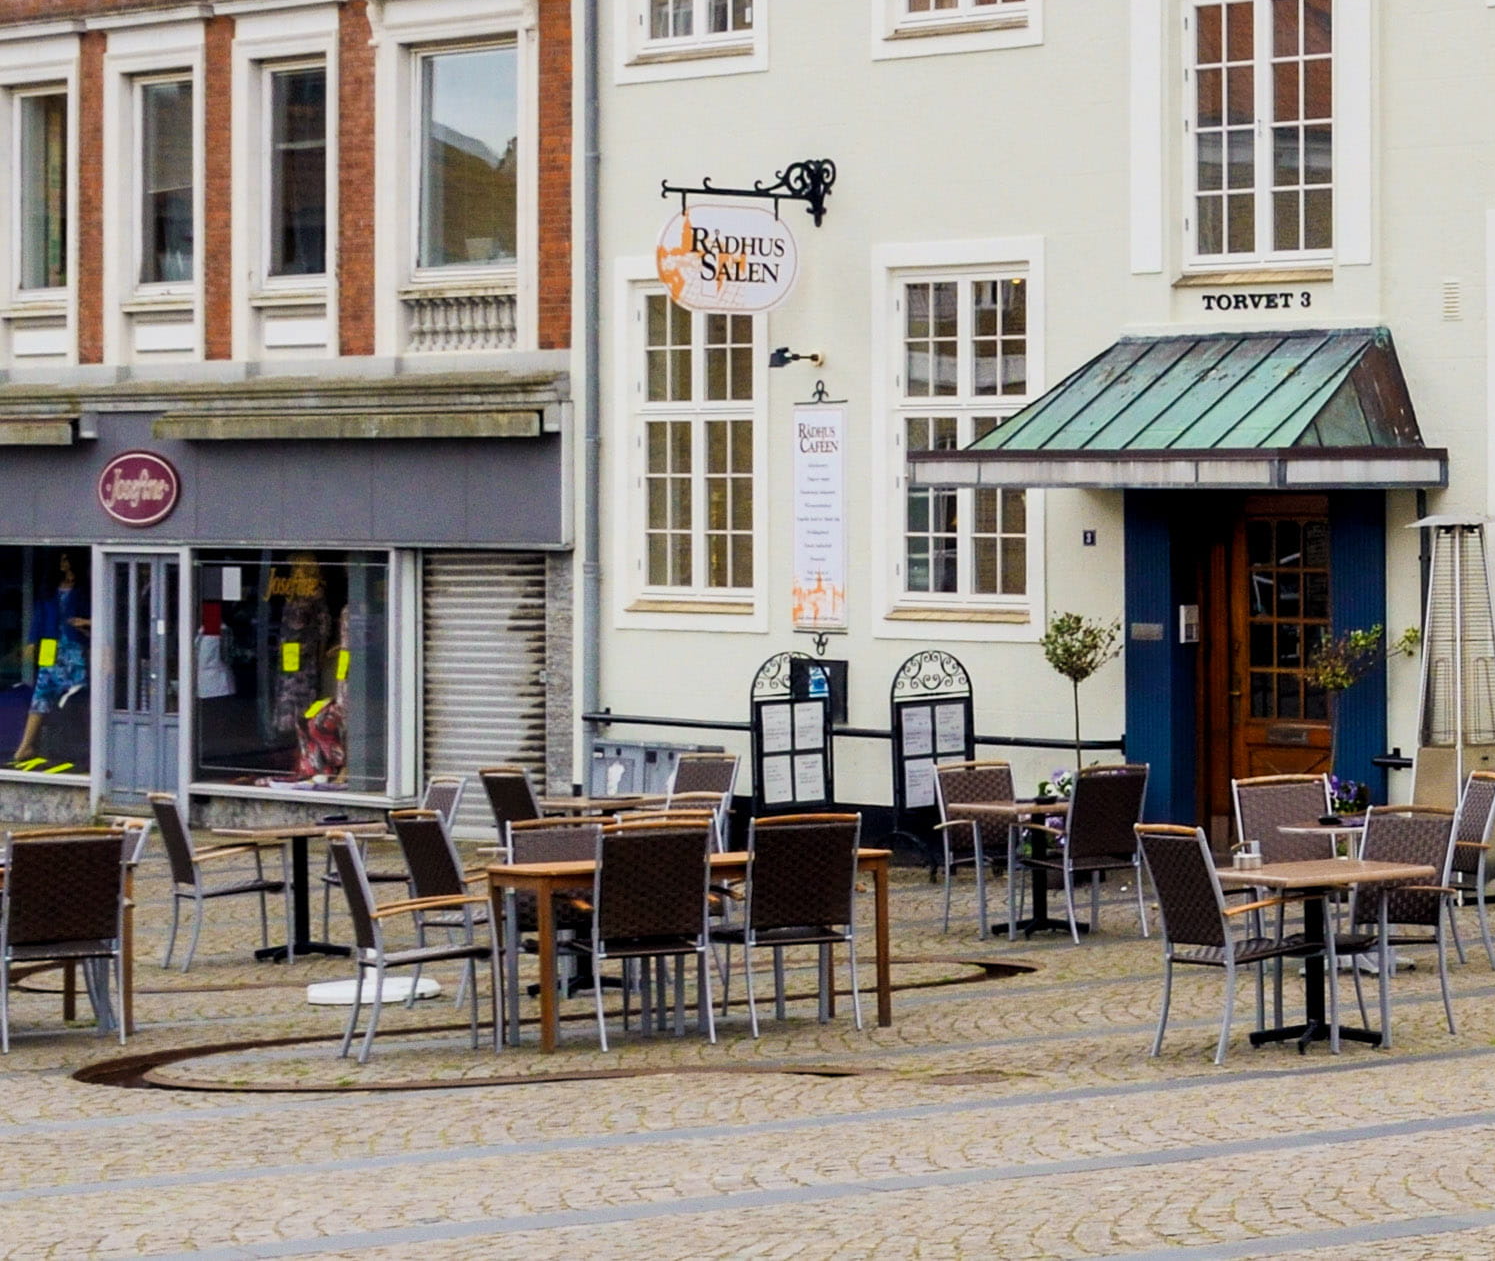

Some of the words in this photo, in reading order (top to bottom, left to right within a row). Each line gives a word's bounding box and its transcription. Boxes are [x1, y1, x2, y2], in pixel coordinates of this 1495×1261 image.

[690, 227, 785, 257] RÅDHUS
[700, 252, 779, 283] SALEN
[1202, 292, 1294, 311] TORVET
[1300, 291, 1311, 308] 3
[105, 468, 166, 508] Josefine
